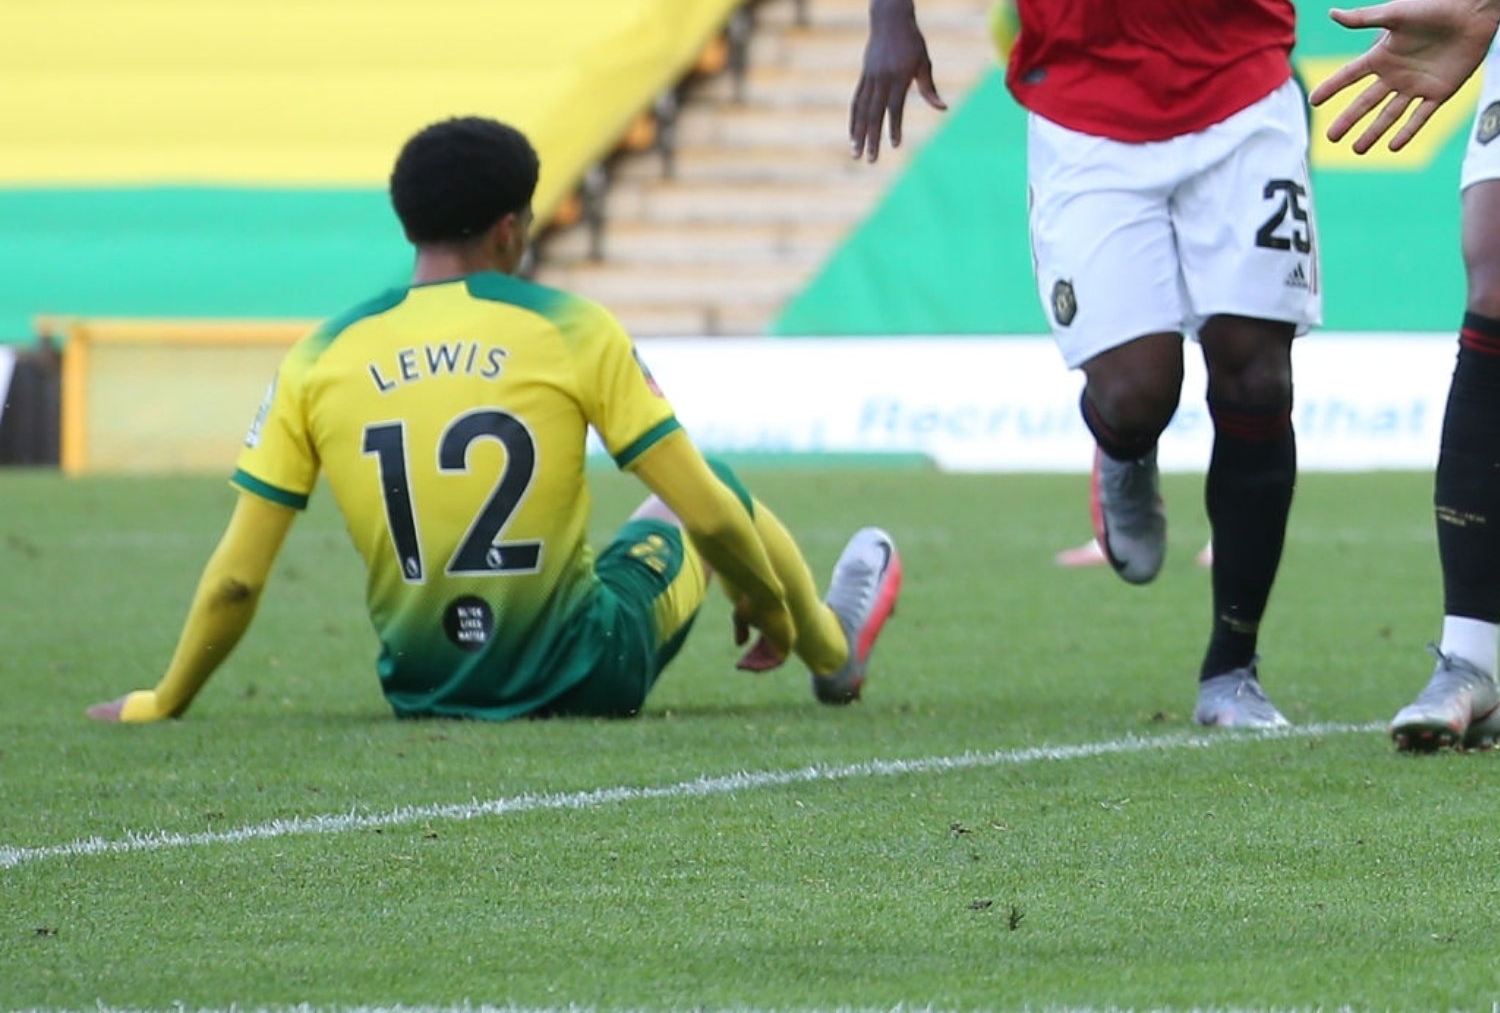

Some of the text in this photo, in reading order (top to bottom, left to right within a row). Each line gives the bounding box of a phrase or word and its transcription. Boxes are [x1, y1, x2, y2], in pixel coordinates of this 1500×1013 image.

[1255, 179, 1311, 254] 25
[369, 341, 508, 393] LEWIS
[363, 408, 544, 584] 12
